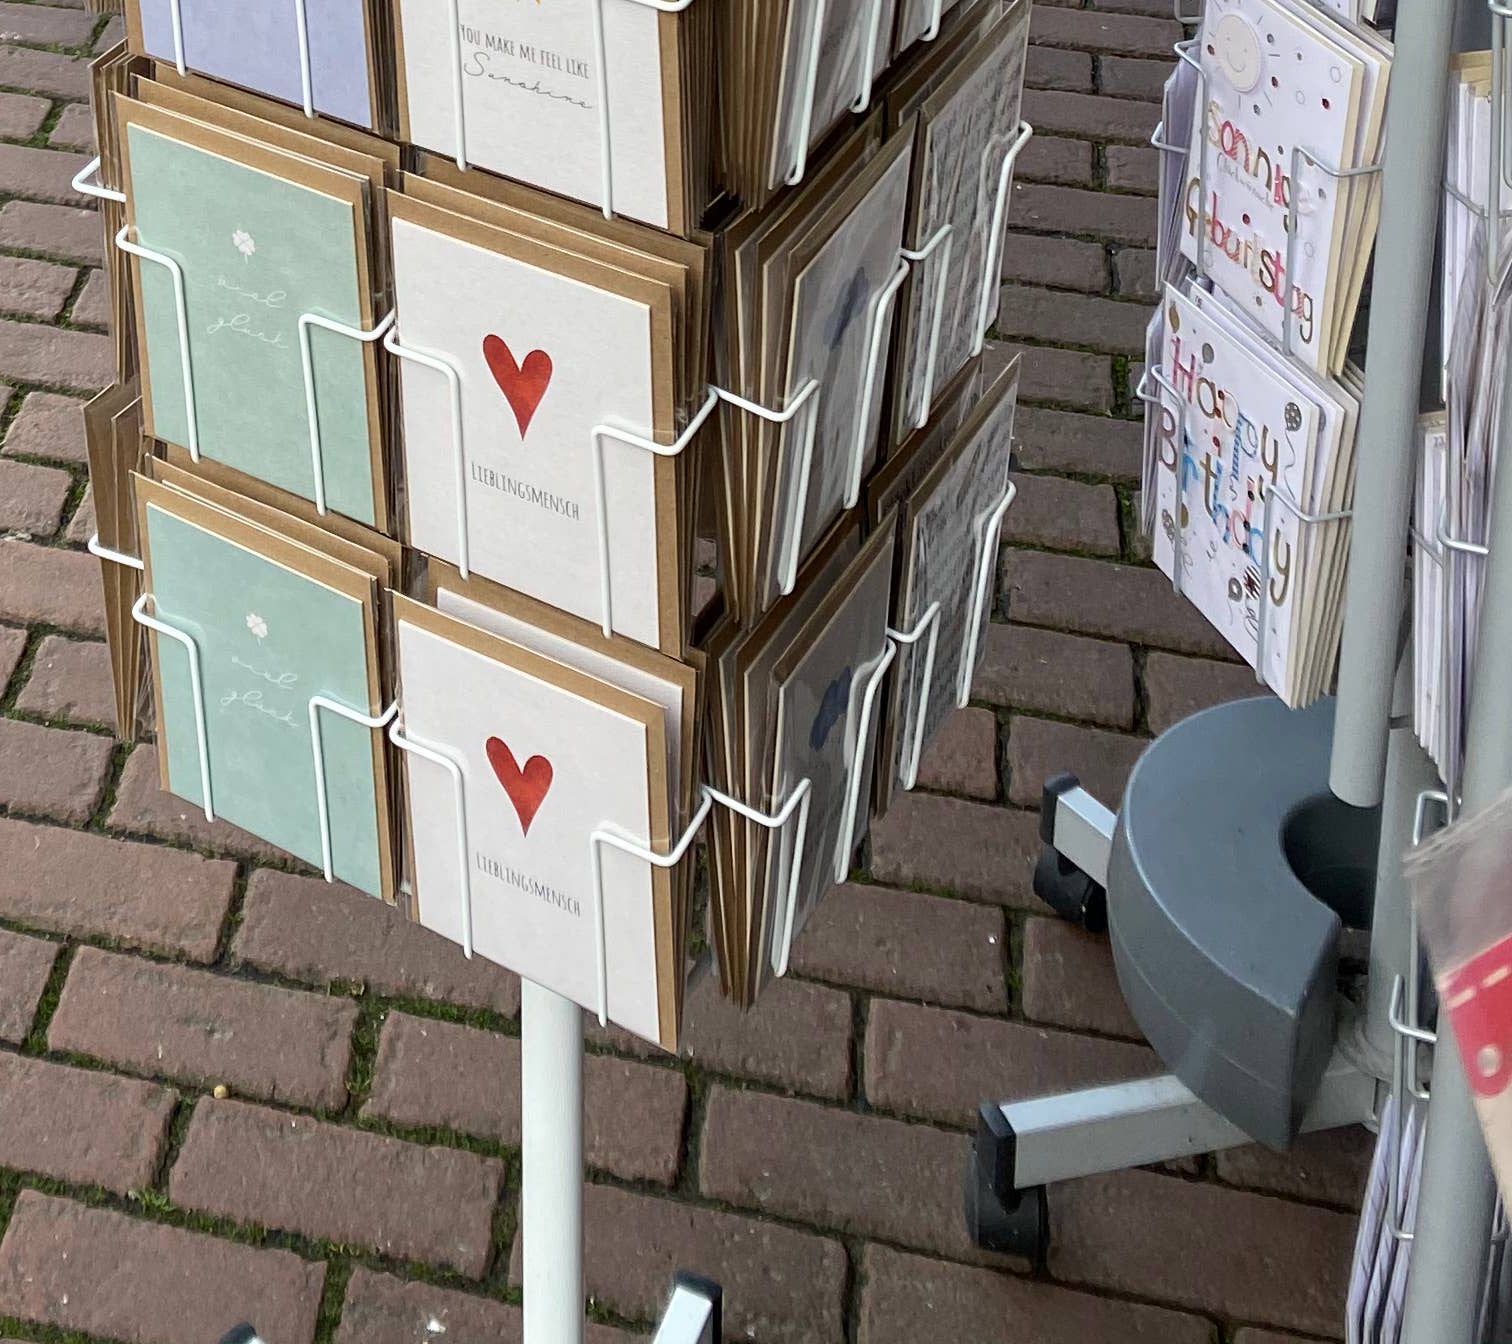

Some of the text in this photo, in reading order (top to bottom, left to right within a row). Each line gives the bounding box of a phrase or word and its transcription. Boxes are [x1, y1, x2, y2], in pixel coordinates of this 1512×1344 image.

[459, 22, 589, 80] YOU MAKE ME FEEL LIKE
[471, 461, 580, 520] LIEBLINGSMENSCH
[475, 852, 581, 917] LIEBLINGSMENSCH
